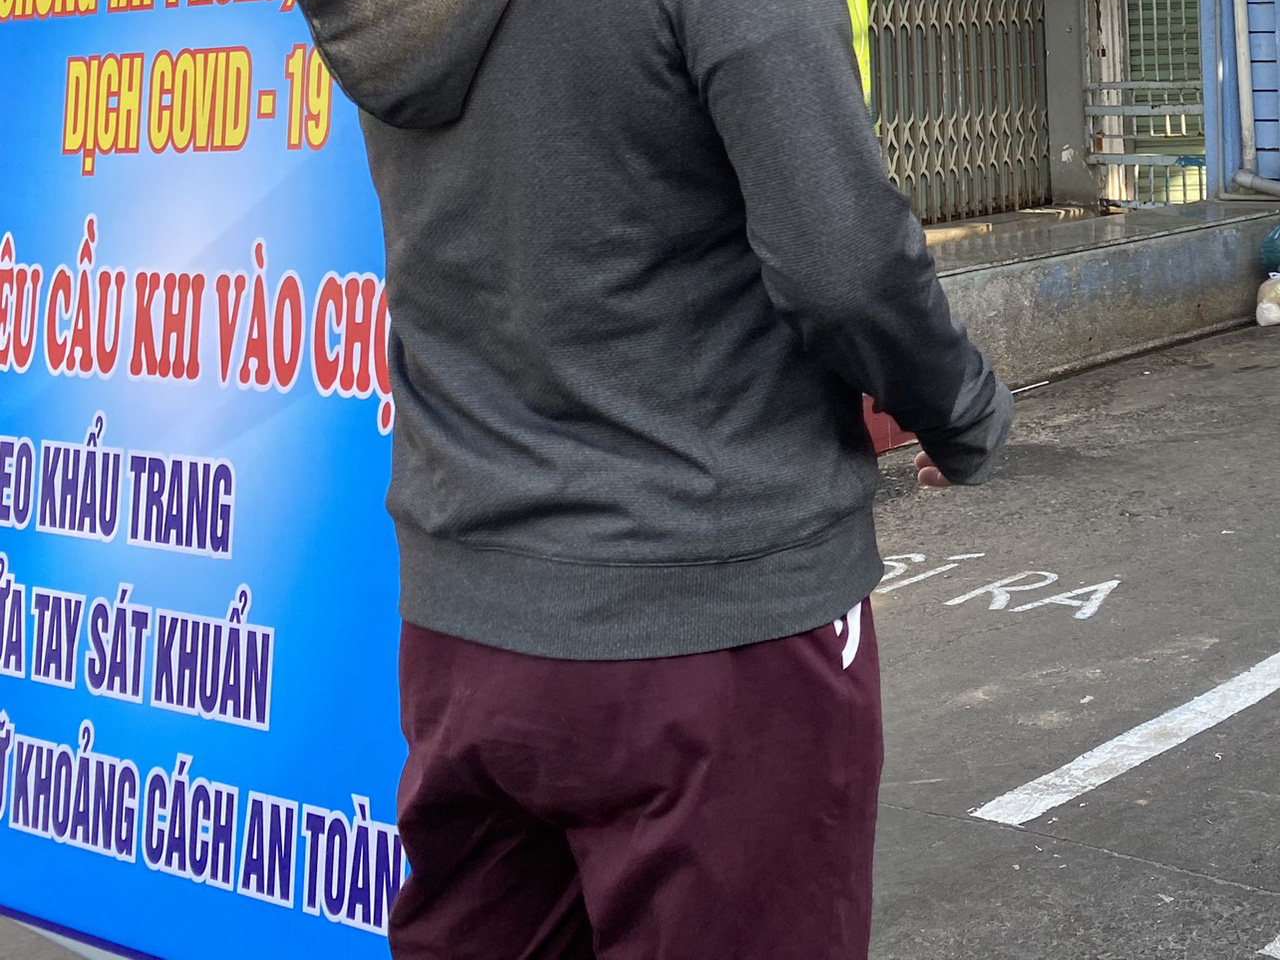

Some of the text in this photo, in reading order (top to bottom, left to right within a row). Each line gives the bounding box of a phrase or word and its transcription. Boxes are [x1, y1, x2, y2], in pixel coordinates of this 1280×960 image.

[63, 52, 143, 175] DỊCH
[149, 46, 250, 153] COVID
[285, 44, 333, 150] 19
[0, 234, 42, 370] ÊU
[46, 216, 126, 373] CẦU
[130, 271, 206, 381] KHI
[216, 242, 302, 388] VÀO
[0, 414, 233, 556] EO KHẨU TRANG
[33, 591, 84, 685] TAY
[87, 588, 149, 698] SÁT
[154, 589, 271, 725] KHUẨN
[942, 570, 1122, 620] RA
[12, 725, 138, 859] KHOẢNG
[144, 758, 237, 888] CÁCH
[240, 797, 294, 903] AN
[302, 802, 399, 930] TOÀN
